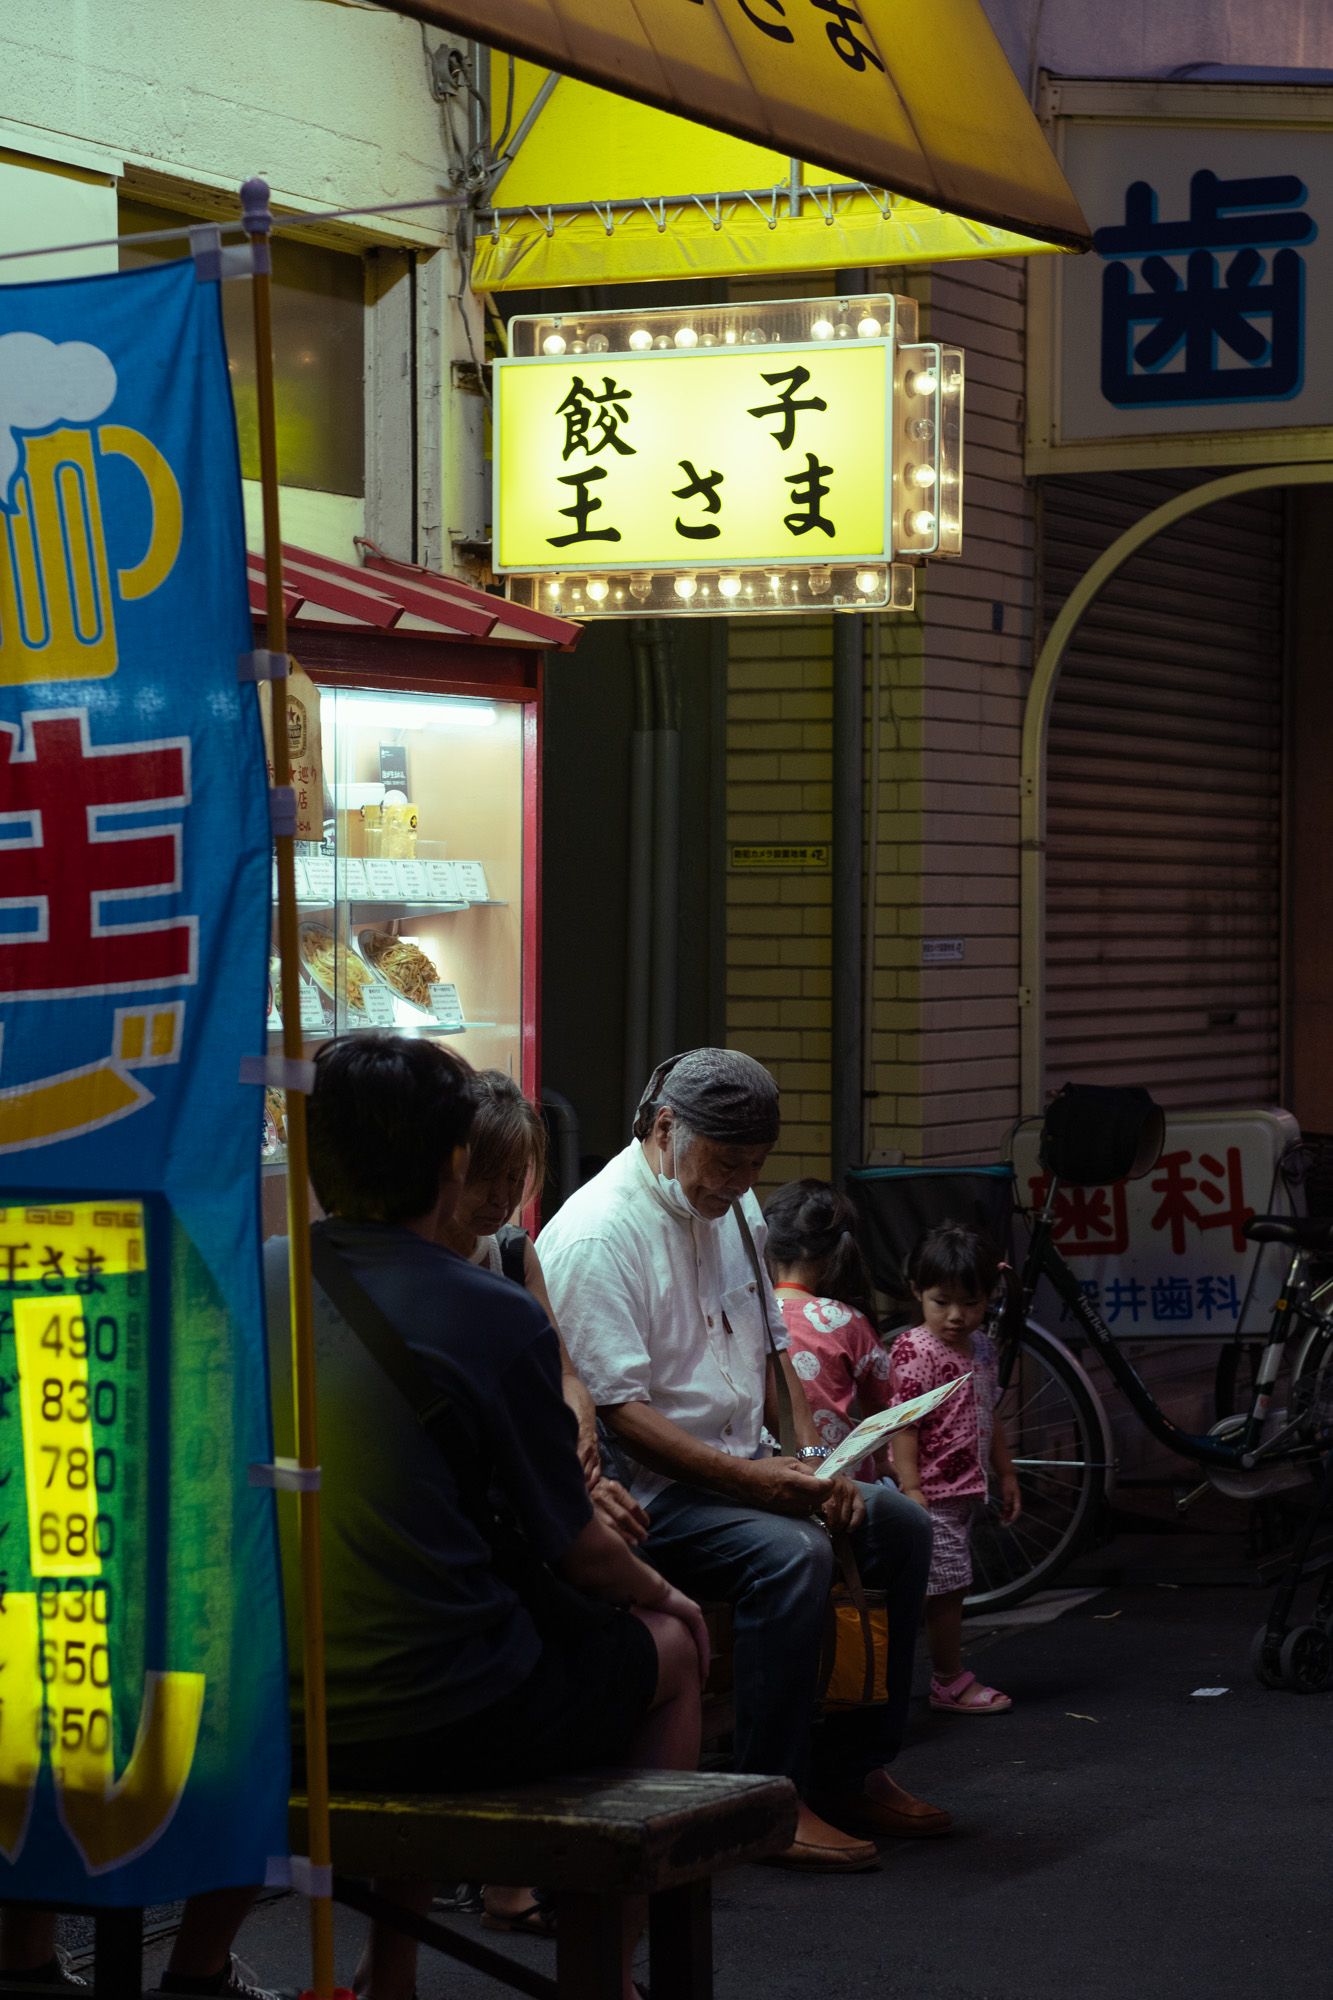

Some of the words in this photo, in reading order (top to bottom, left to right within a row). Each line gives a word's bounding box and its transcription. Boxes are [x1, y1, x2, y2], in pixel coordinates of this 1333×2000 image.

[1093, 168, 1319, 411] 歯
[554, 364, 828, 462] 餃子
[545, 452, 836, 548] 王さま
[40, 1314, 118, 1362] 490
[41, 1377, 117, 1426] 830
[40, 1445, 116, 1494] 780
[39, 1510, 115, 1559] 680
[38, 1640, 112, 1689] 650
[35, 1705, 111, 1755] 650
